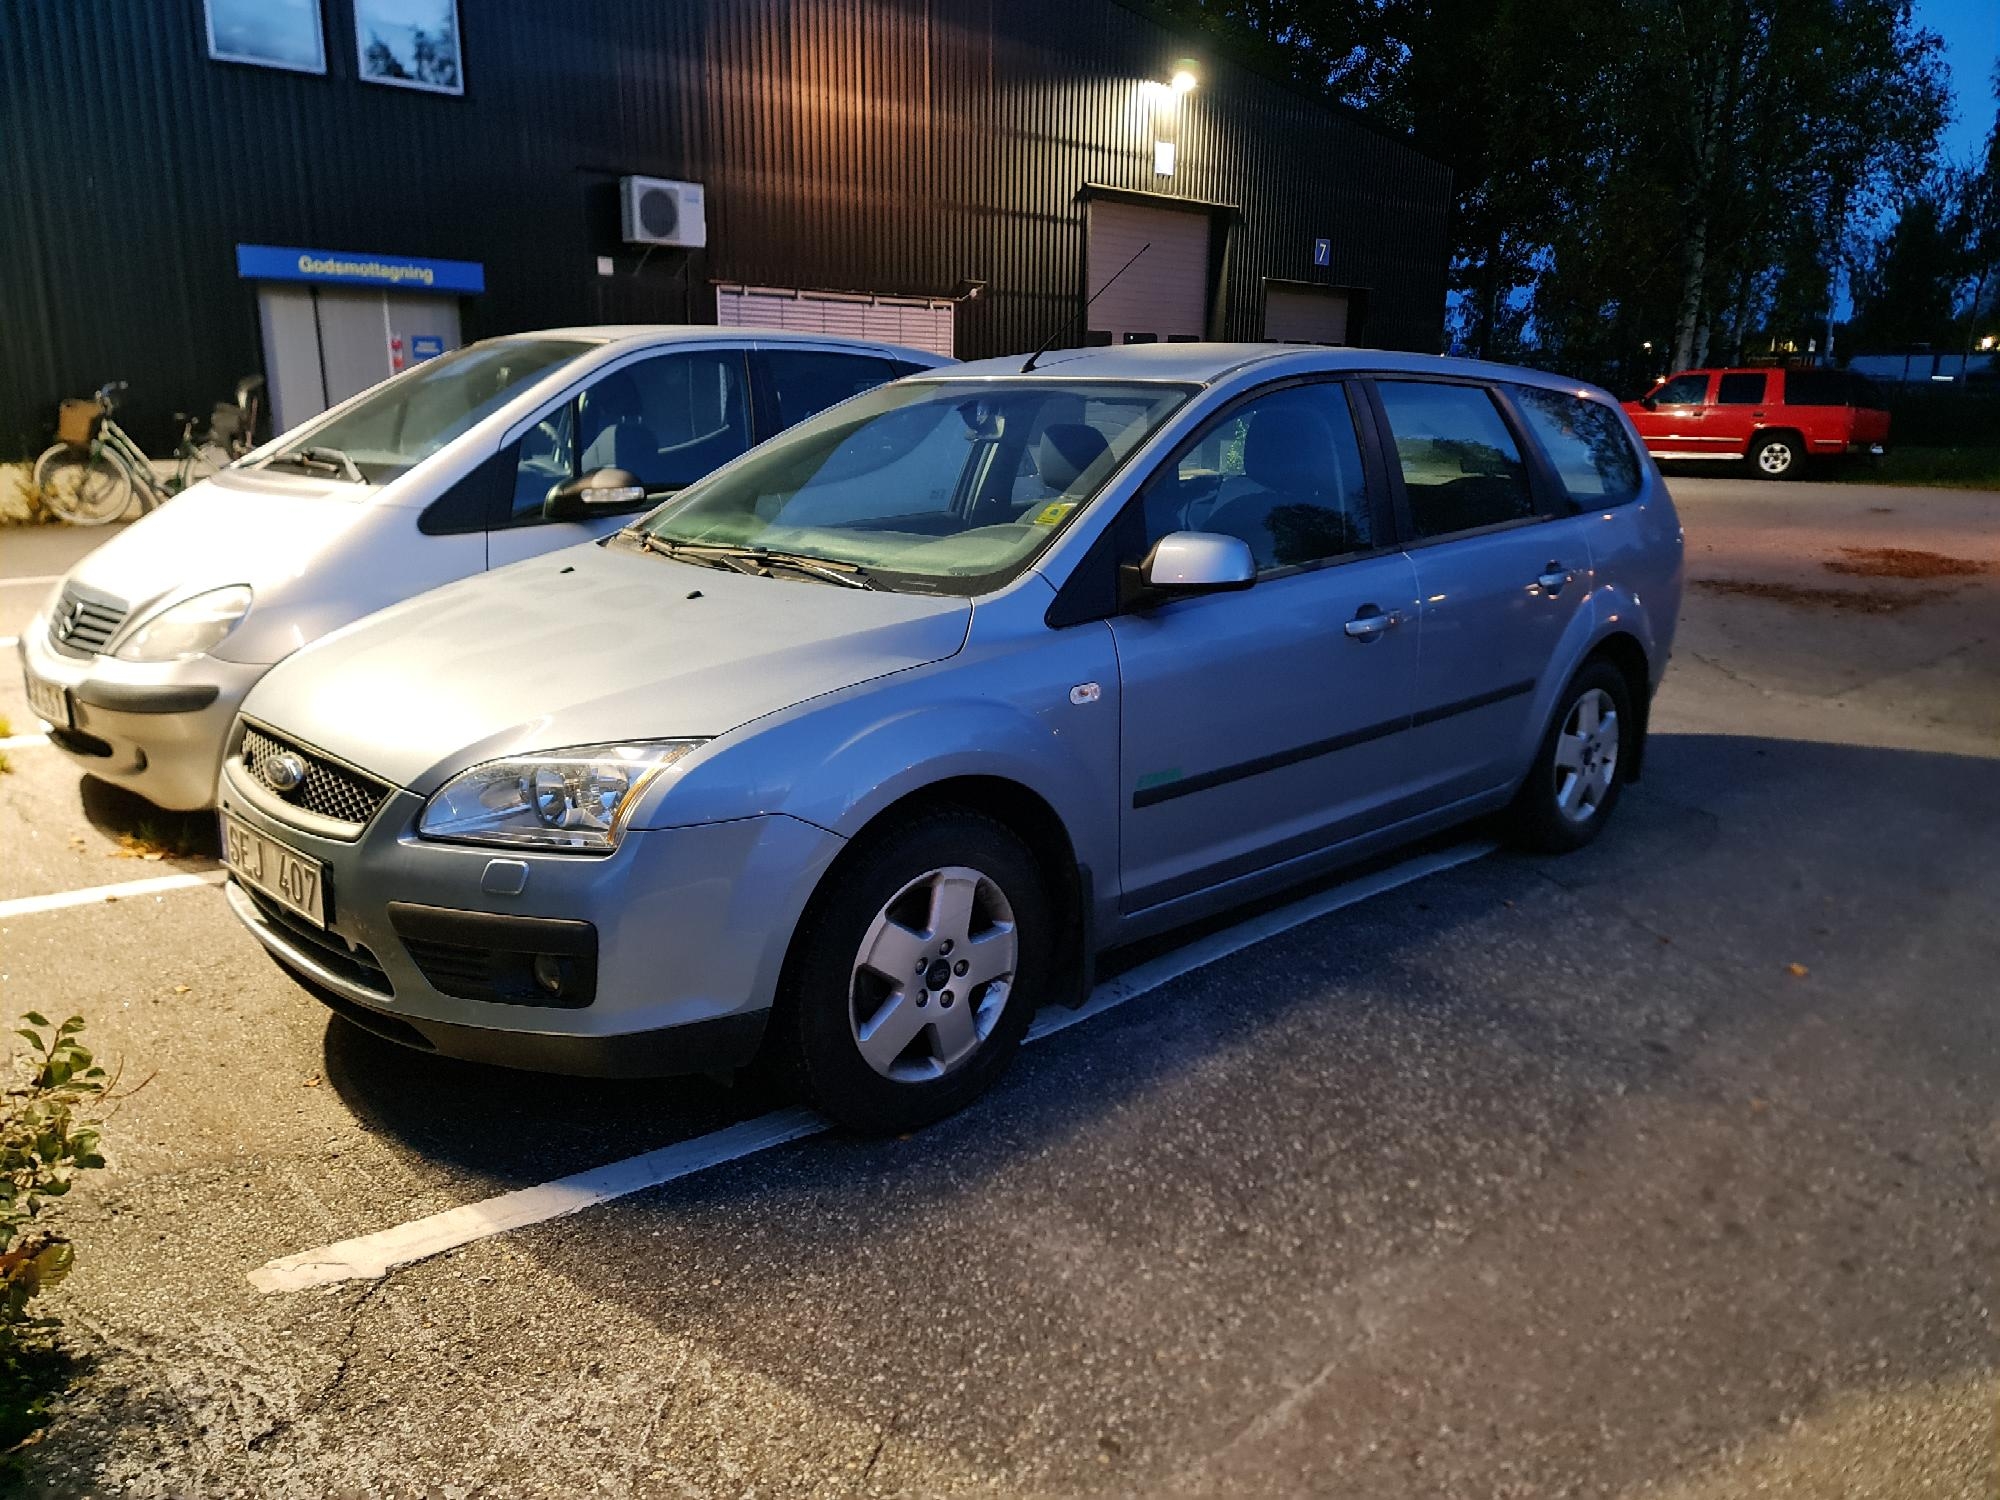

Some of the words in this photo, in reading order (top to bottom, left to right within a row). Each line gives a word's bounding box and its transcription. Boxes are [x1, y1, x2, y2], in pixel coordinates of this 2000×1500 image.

[1319, 243, 1327, 262] 7
[229, 825, 263, 880] SEJ
[279, 852, 317, 912] 407
